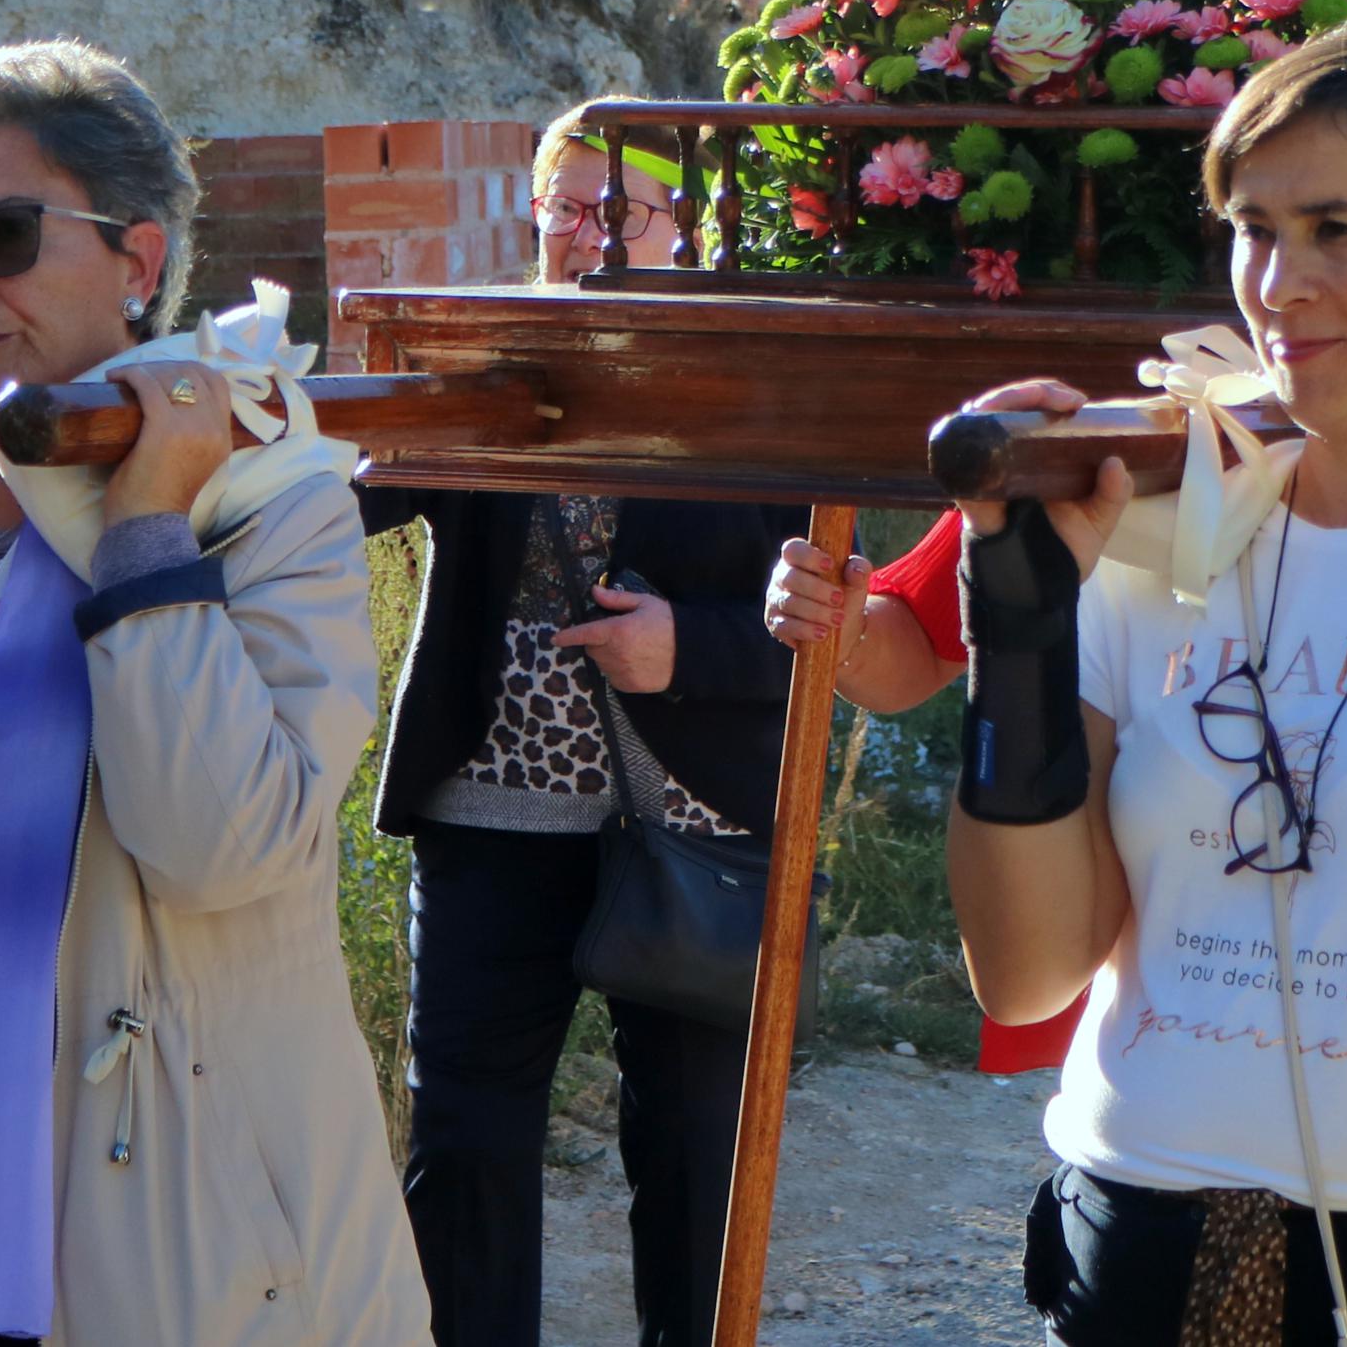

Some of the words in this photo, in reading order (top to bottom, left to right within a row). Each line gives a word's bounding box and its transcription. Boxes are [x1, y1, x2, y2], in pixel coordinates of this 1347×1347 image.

[1175, 928, 1241, 956] begins
[1179, 962, 1214, 982] you
[1316, 978, 1337, 999] to
